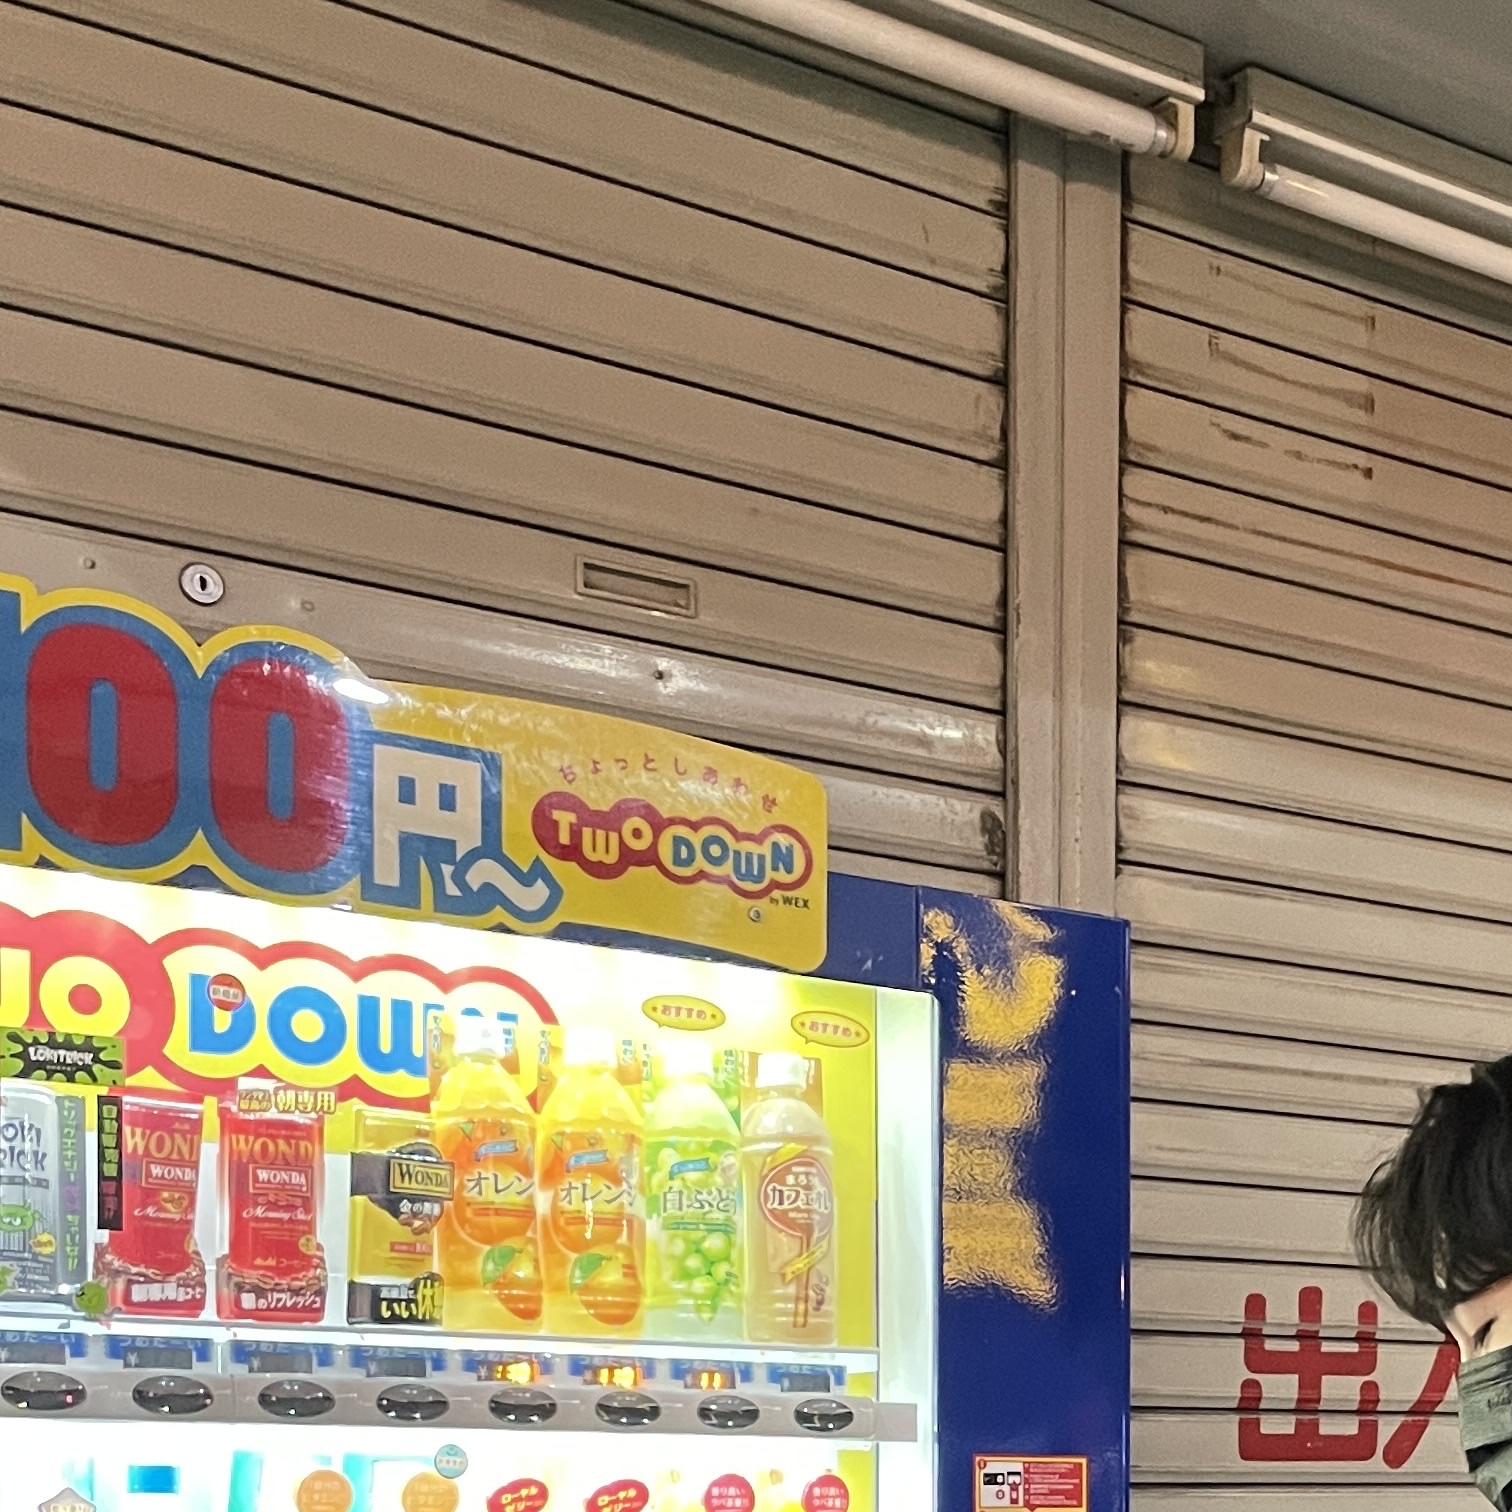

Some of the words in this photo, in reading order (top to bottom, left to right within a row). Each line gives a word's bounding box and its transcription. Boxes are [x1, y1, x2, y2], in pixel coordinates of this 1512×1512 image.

[558, 752, 778, 814] ちょっとしあわせ
[551, 808, 655, 864] TWO
[671, 833, 795, 885] DOWN
[781, 894, 811, 910] WEX
[188, 972, 519, 1078] DOW
[124, 1125, 200, 1161] WON
